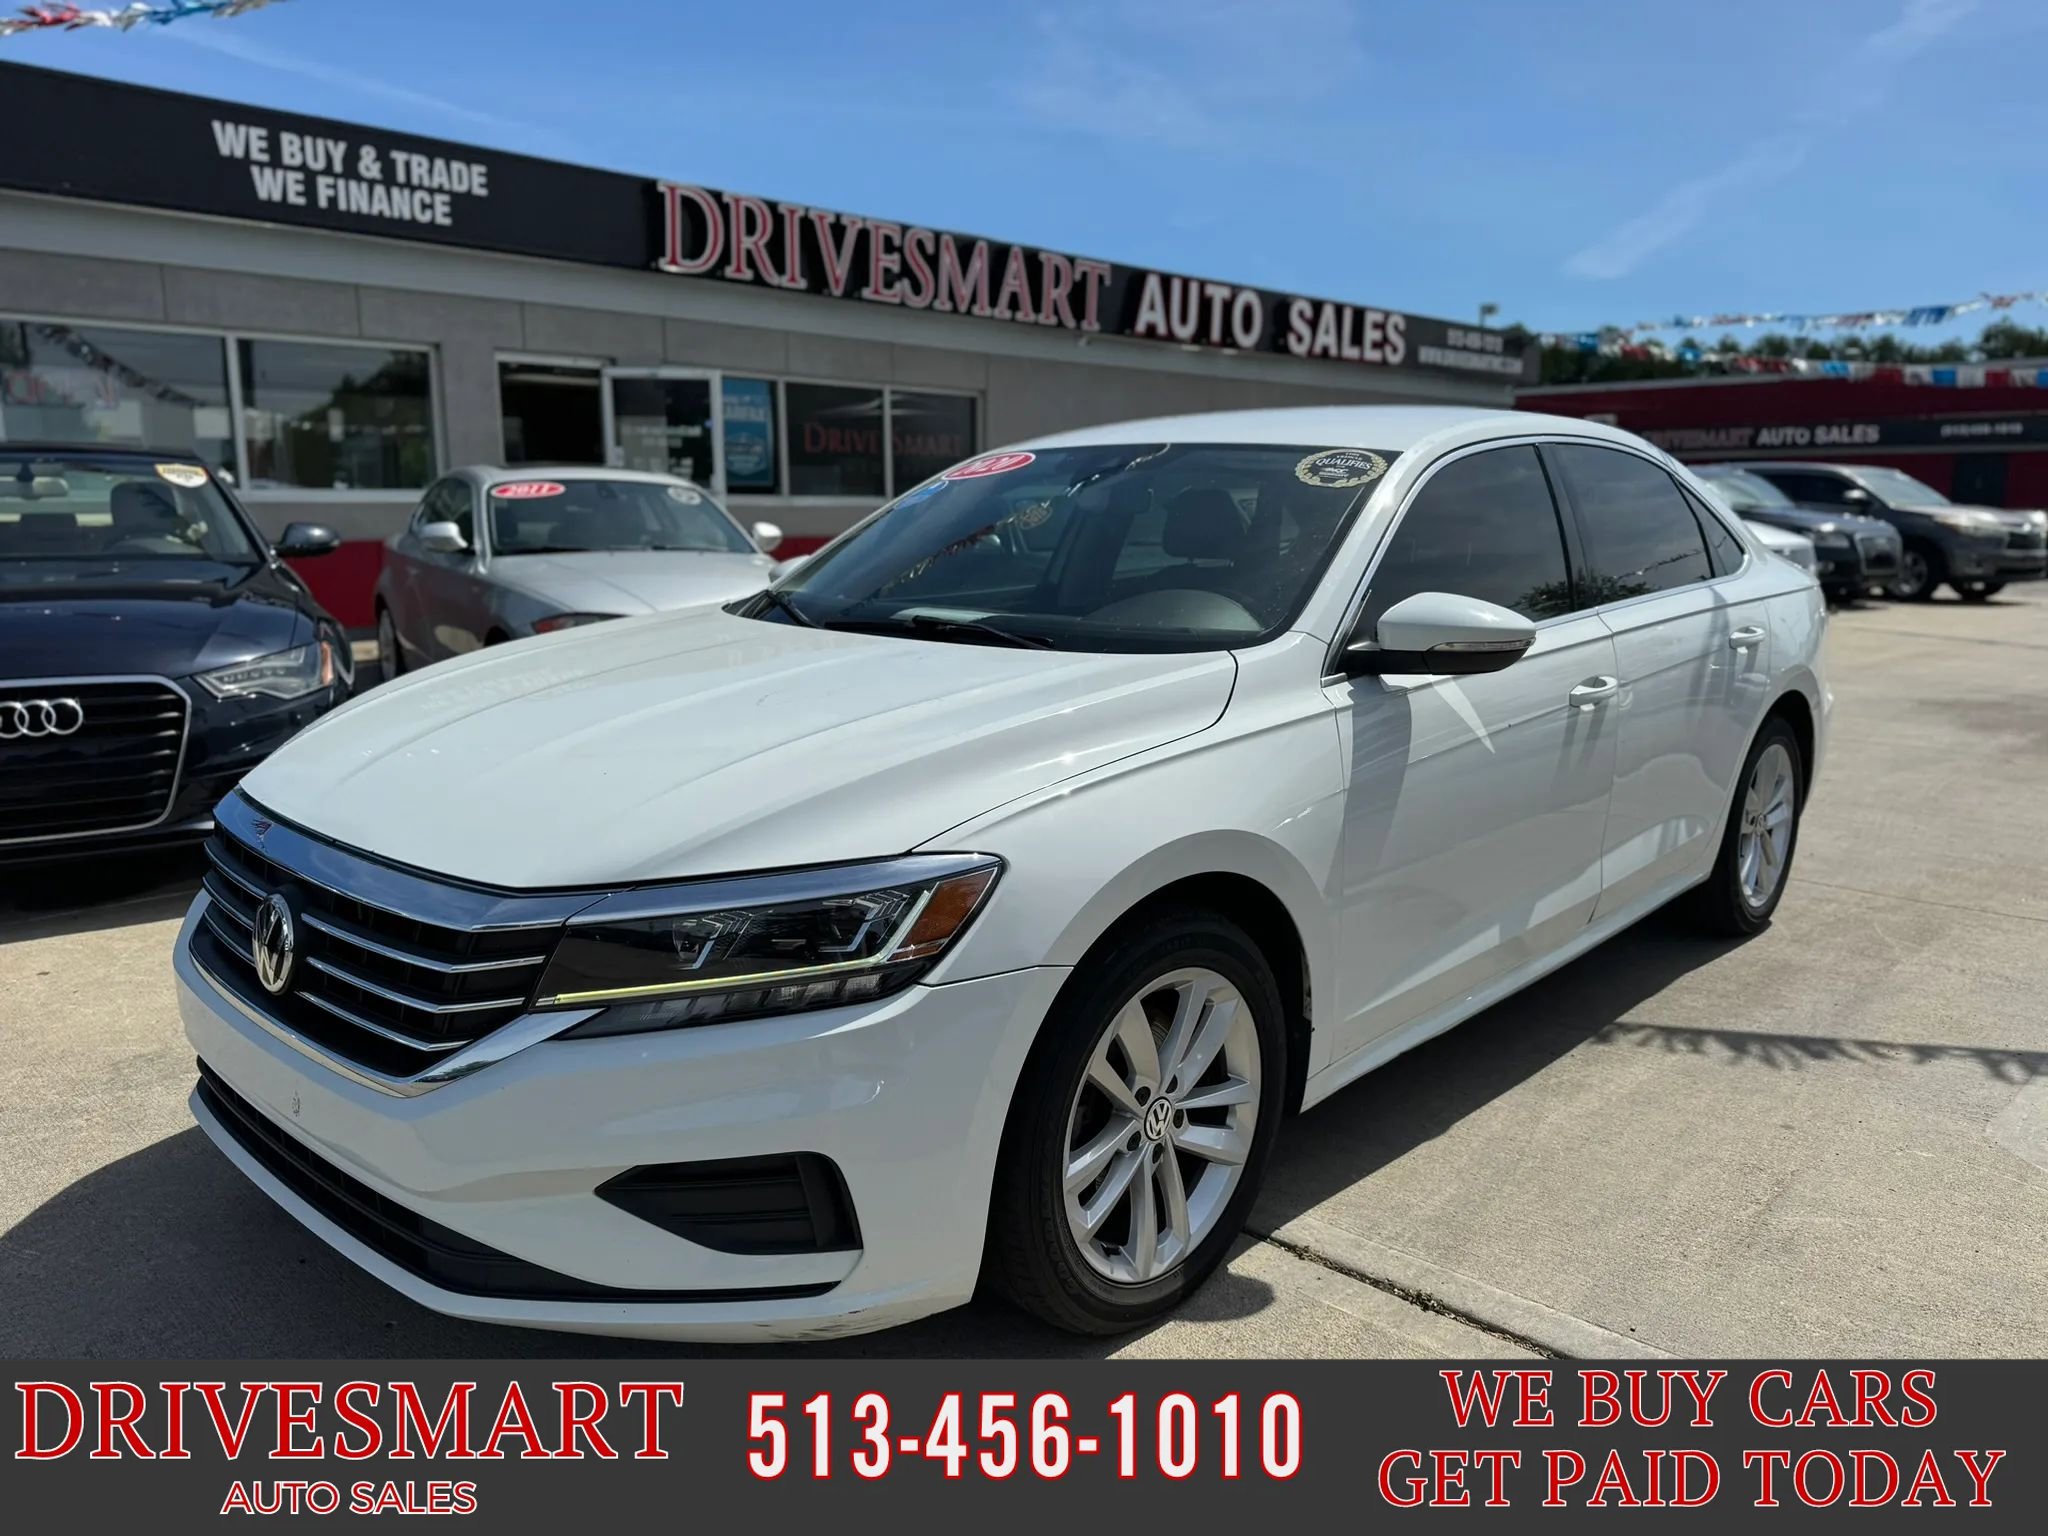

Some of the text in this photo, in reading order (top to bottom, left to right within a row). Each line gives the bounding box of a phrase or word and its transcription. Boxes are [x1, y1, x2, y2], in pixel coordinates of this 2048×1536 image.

[212, 120, 489, 197] WE BUY & TRADE
[250, 165, 452, 227] WE FINANCE
[656, 181, 1407, 366] DRIVESMART AUTO SALES
[1315, 458, 1373, 470] QUALIFIES
[1756, 426, 1811, 447] AUTO
[1814, 424, 1881, 445] SALES
